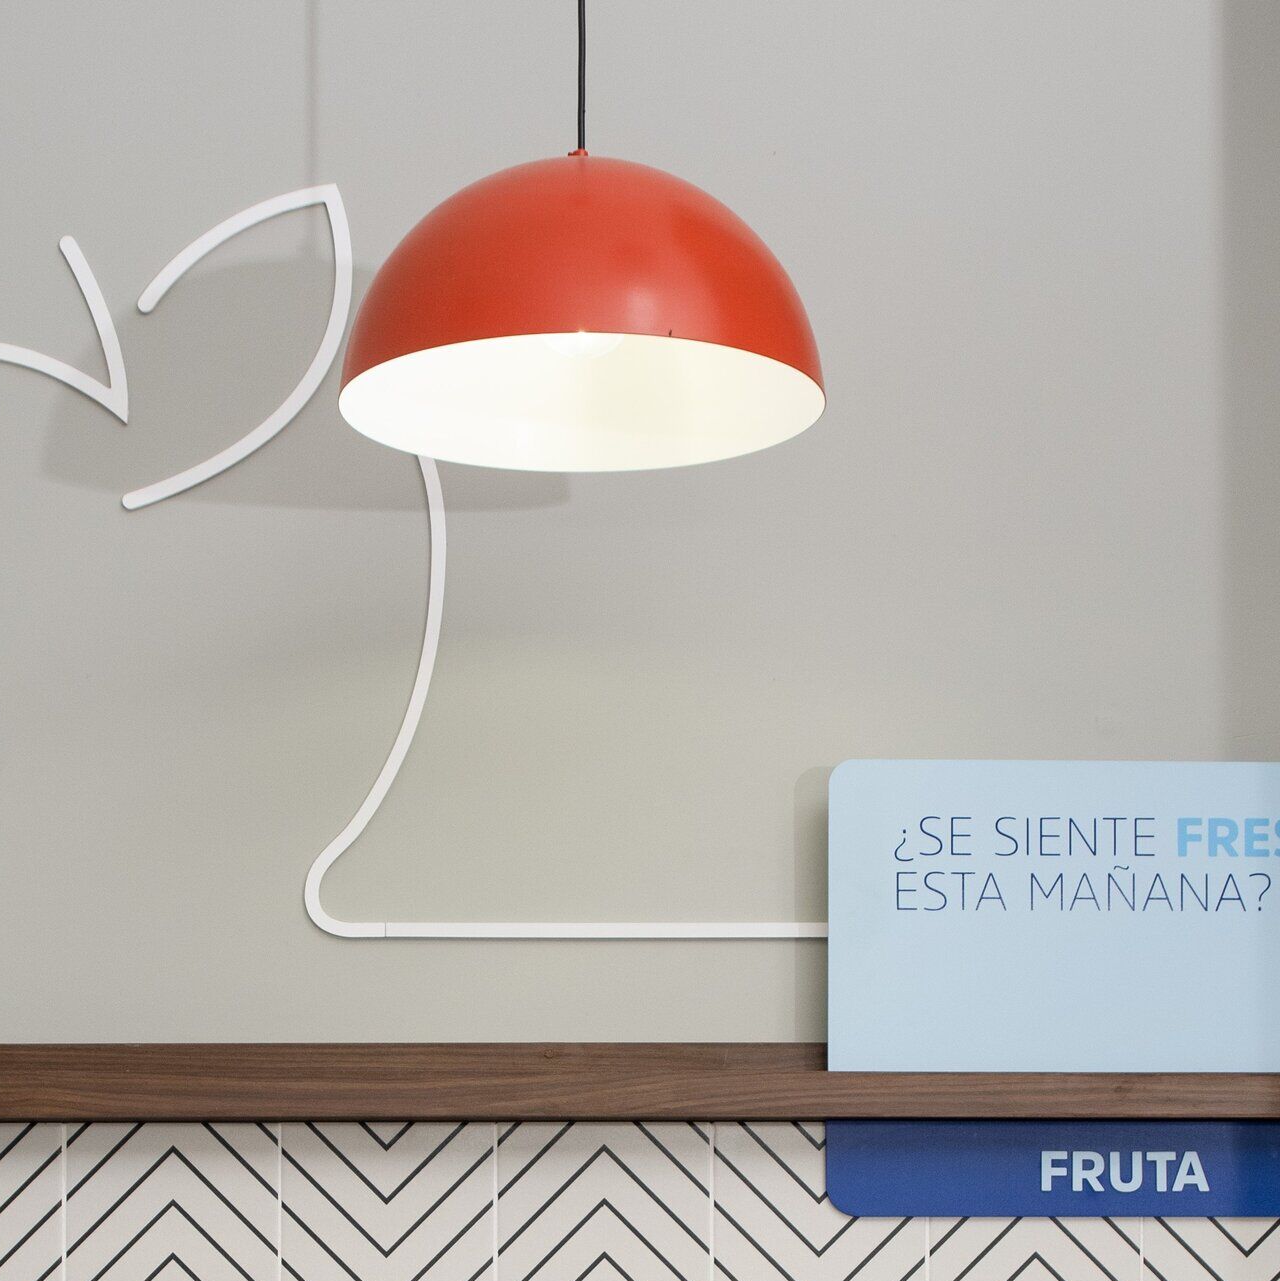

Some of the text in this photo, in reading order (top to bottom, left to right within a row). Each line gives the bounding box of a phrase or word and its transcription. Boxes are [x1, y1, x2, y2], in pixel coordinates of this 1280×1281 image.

[893, 815, 972, 862] ¿SE
[994, 816, 1156, 858] SIENTE
[895, 865, 1272, 912] ESTA MAÑANA?
[1040, 1149, 1210, 1193] FRUTA
